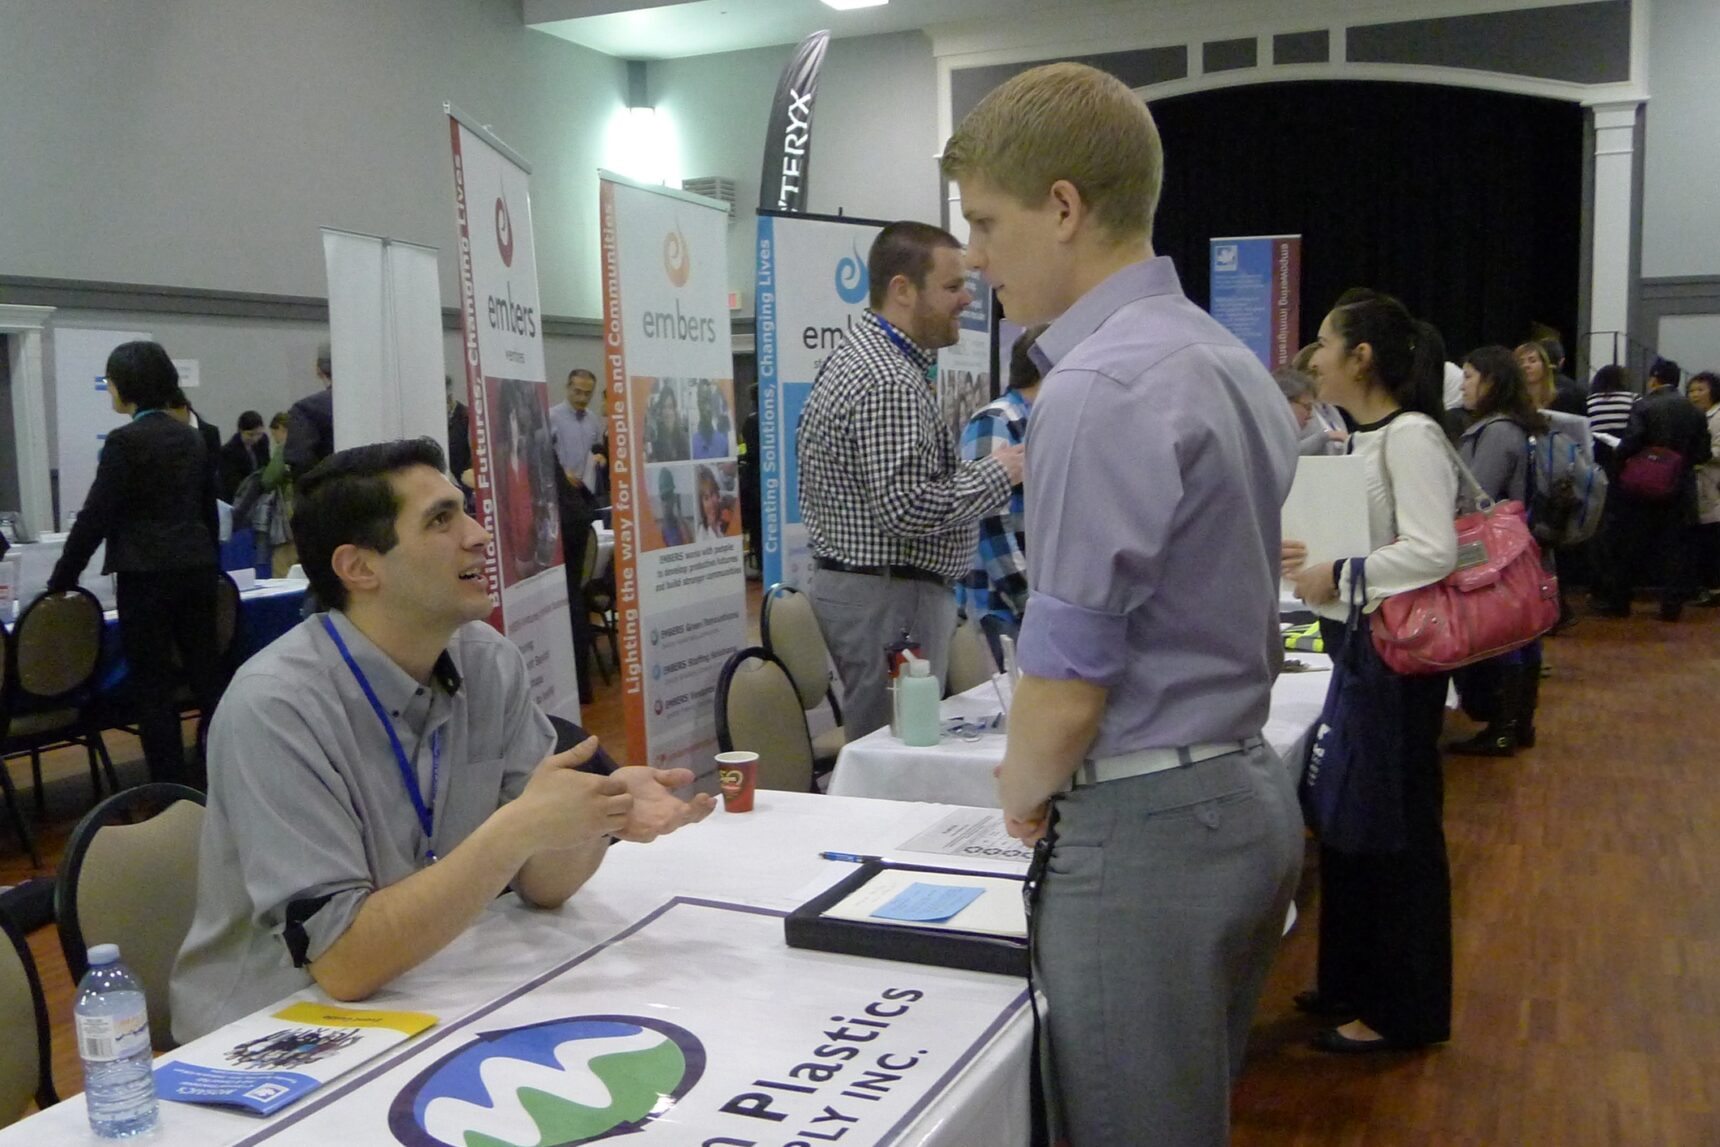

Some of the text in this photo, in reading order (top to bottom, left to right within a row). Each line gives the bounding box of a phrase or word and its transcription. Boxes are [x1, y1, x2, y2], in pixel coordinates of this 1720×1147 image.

[453, 156, 467, 226] Lives
[459, 236, 480, 367] Changing
[488, 280, 536, 338] embers
[643, 298, 717, 344] embers
[603, 202, 641, 694] Lighting the way for People and Communities
[758, 239, 780, 554] Creating Solutions, Changing Lives
[480, 498, 501, 608] Buildng
[718, 987, 924, 1121] Plastics
[841, 1049, 928, 1101] INC.
